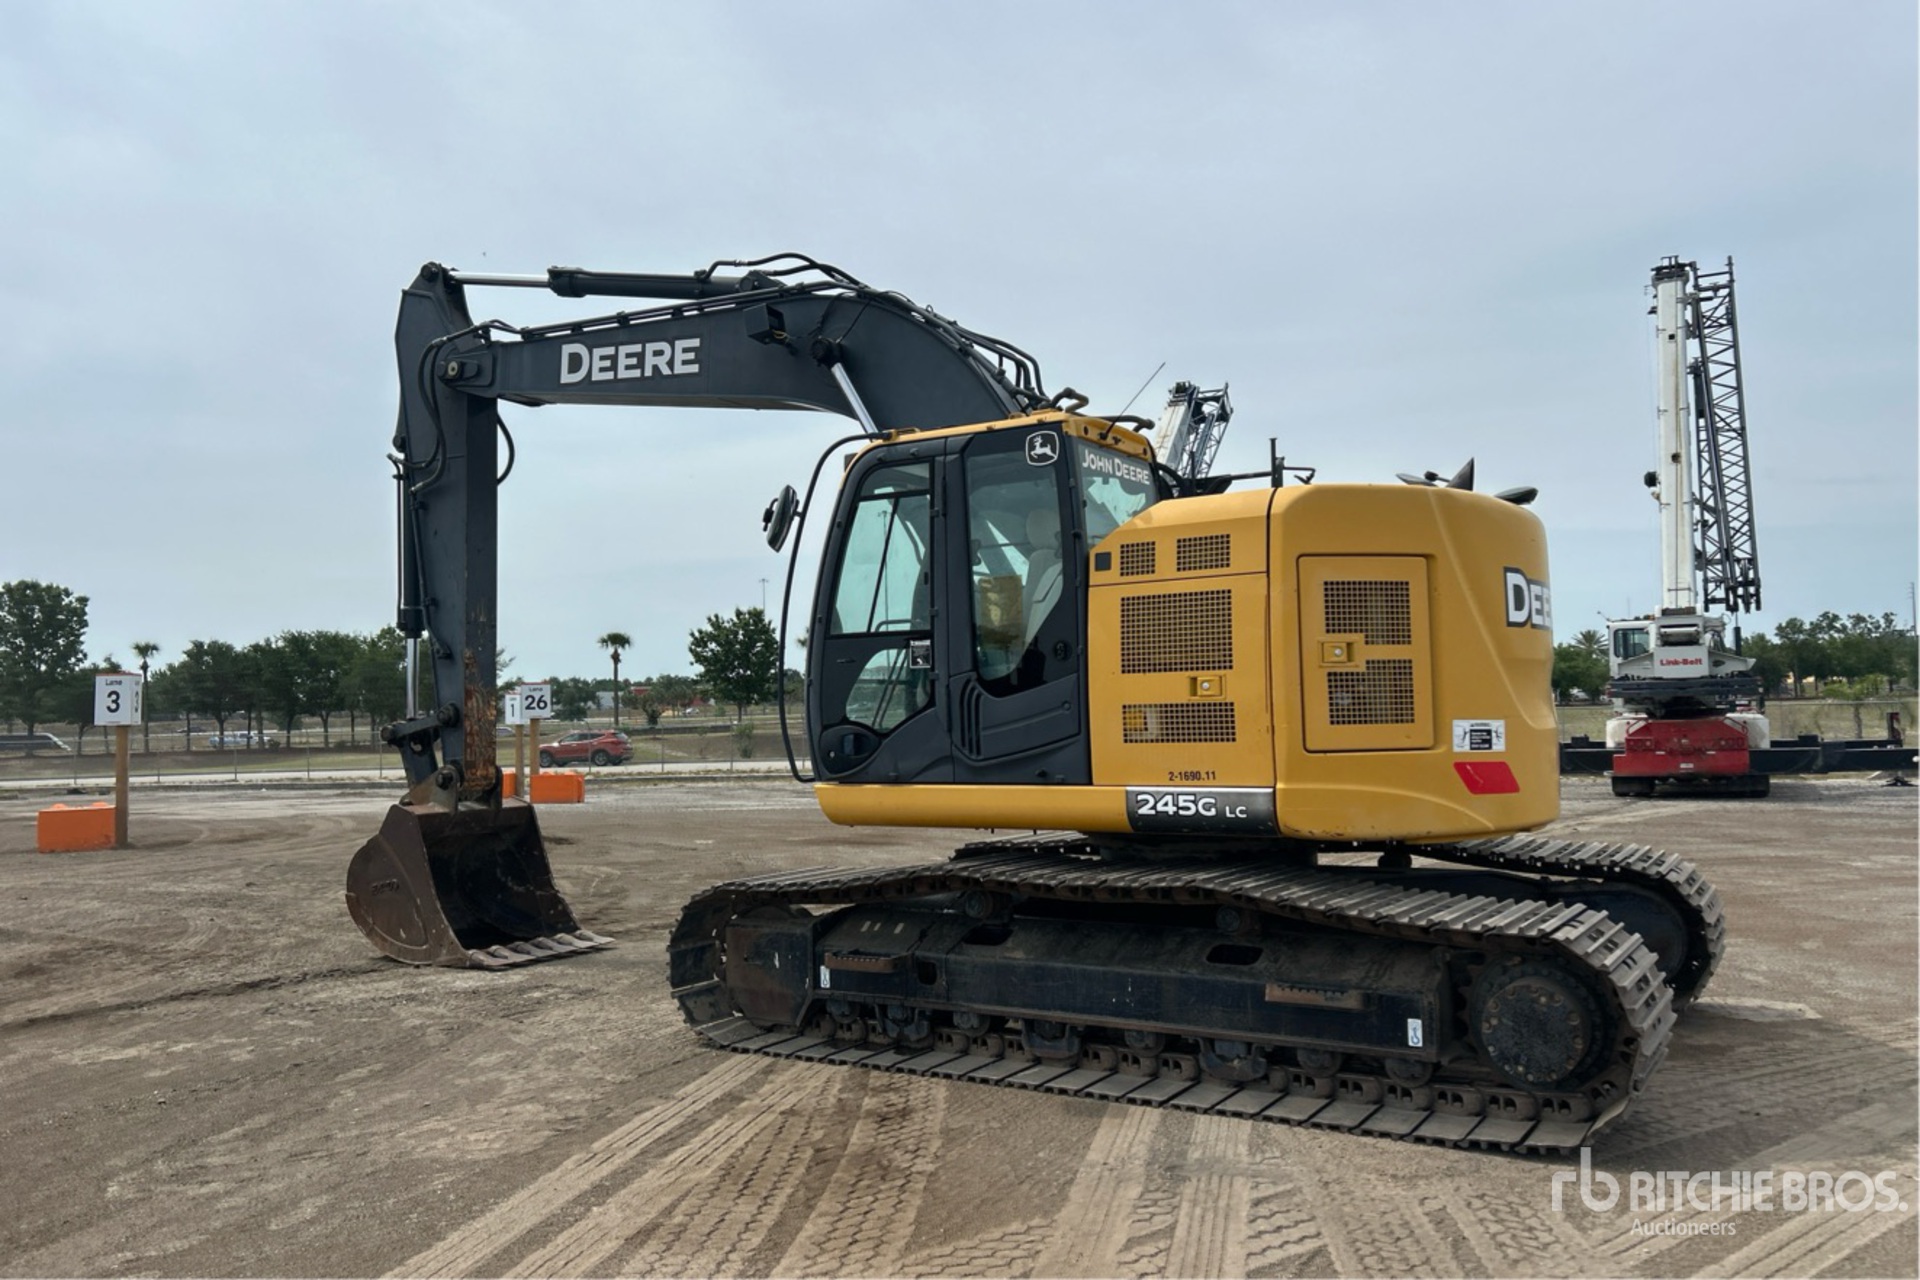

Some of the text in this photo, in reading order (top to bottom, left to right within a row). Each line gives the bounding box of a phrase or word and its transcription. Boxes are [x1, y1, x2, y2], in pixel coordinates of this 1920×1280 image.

[560, 338, 700, 384] DEERE
[1082, 449, 1150, 485] JOHN DEERE
[106, 690, 120, 713] 3
[524, 694, 548, 710] 26
[1168, 771, 1216, 781] 2-1690.11
[1136, 794, 1247, 818] 245G LC
